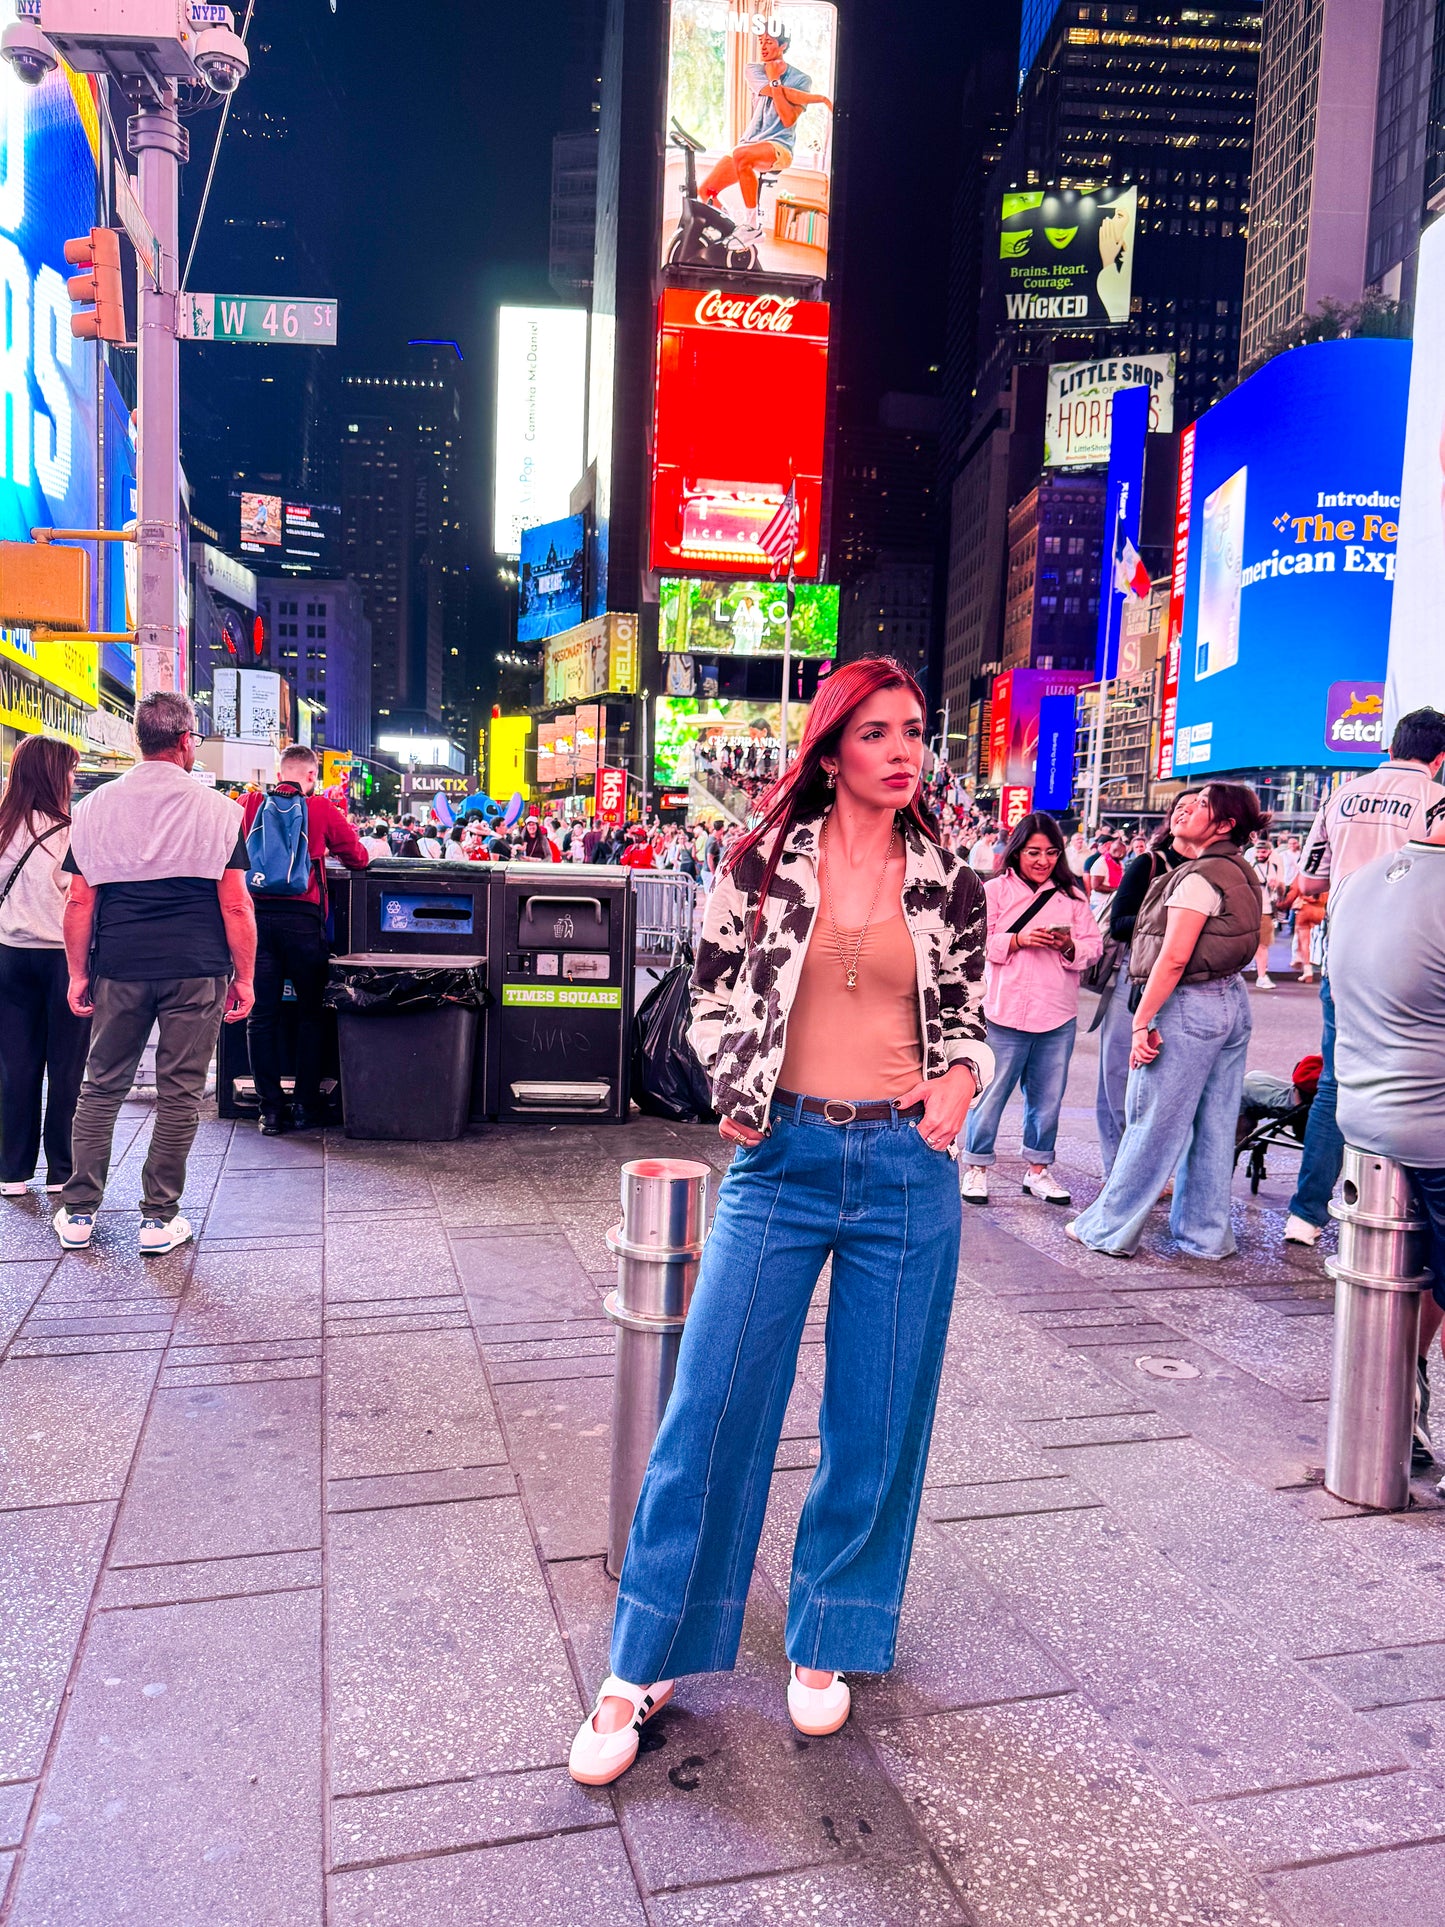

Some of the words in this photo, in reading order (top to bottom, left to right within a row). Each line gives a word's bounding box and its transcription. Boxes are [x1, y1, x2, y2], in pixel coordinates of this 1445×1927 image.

[192, 5, 226, 21] NYPD
[1010, 266, 1050, 277] Brains.
[1052, 264, 1088, 276] Heart.
[1023, 278, 1074, 290] Courage.
[221, 301, 247, 334] W
[261, 303, 299, 338] 46
[312, 305, 332, 326] St
[694, 289, 799, 332] Coca-Cola
[527, 321, 538, 382] McDaniel
[1060, 362, 1118, 399] LITTLE
[1122, 362, 1164, 390] SHOP
[1102, 386, 1114, 394] OF
[525, 386, 537, 442] Camisha
[1177, 429, 1195, 534] HERSHEY'S
[1316, 491, 1401, 508] Introduc
[692, 528, 723, 540] ICE
[736, 531, 760, 541] CO
[1290, 513, 1356, 543] The
[1362, 515, 1398, 543] Fe
[1174, 536, 1189, 599] STORE
[616, 618, 633, 690] HELLO!
[1163, 697, 1177, 740] FREE
[412, 777, 469, 791] KLIKTIX
[602, 771, 623, 810] tkts
[1007, 788, 1028, 827] tkts
[1340, 794, 1412, 818] Corona
[505, 989, 555, 1002] TIMES
[558, 990, 619, 1004] SQUARE
